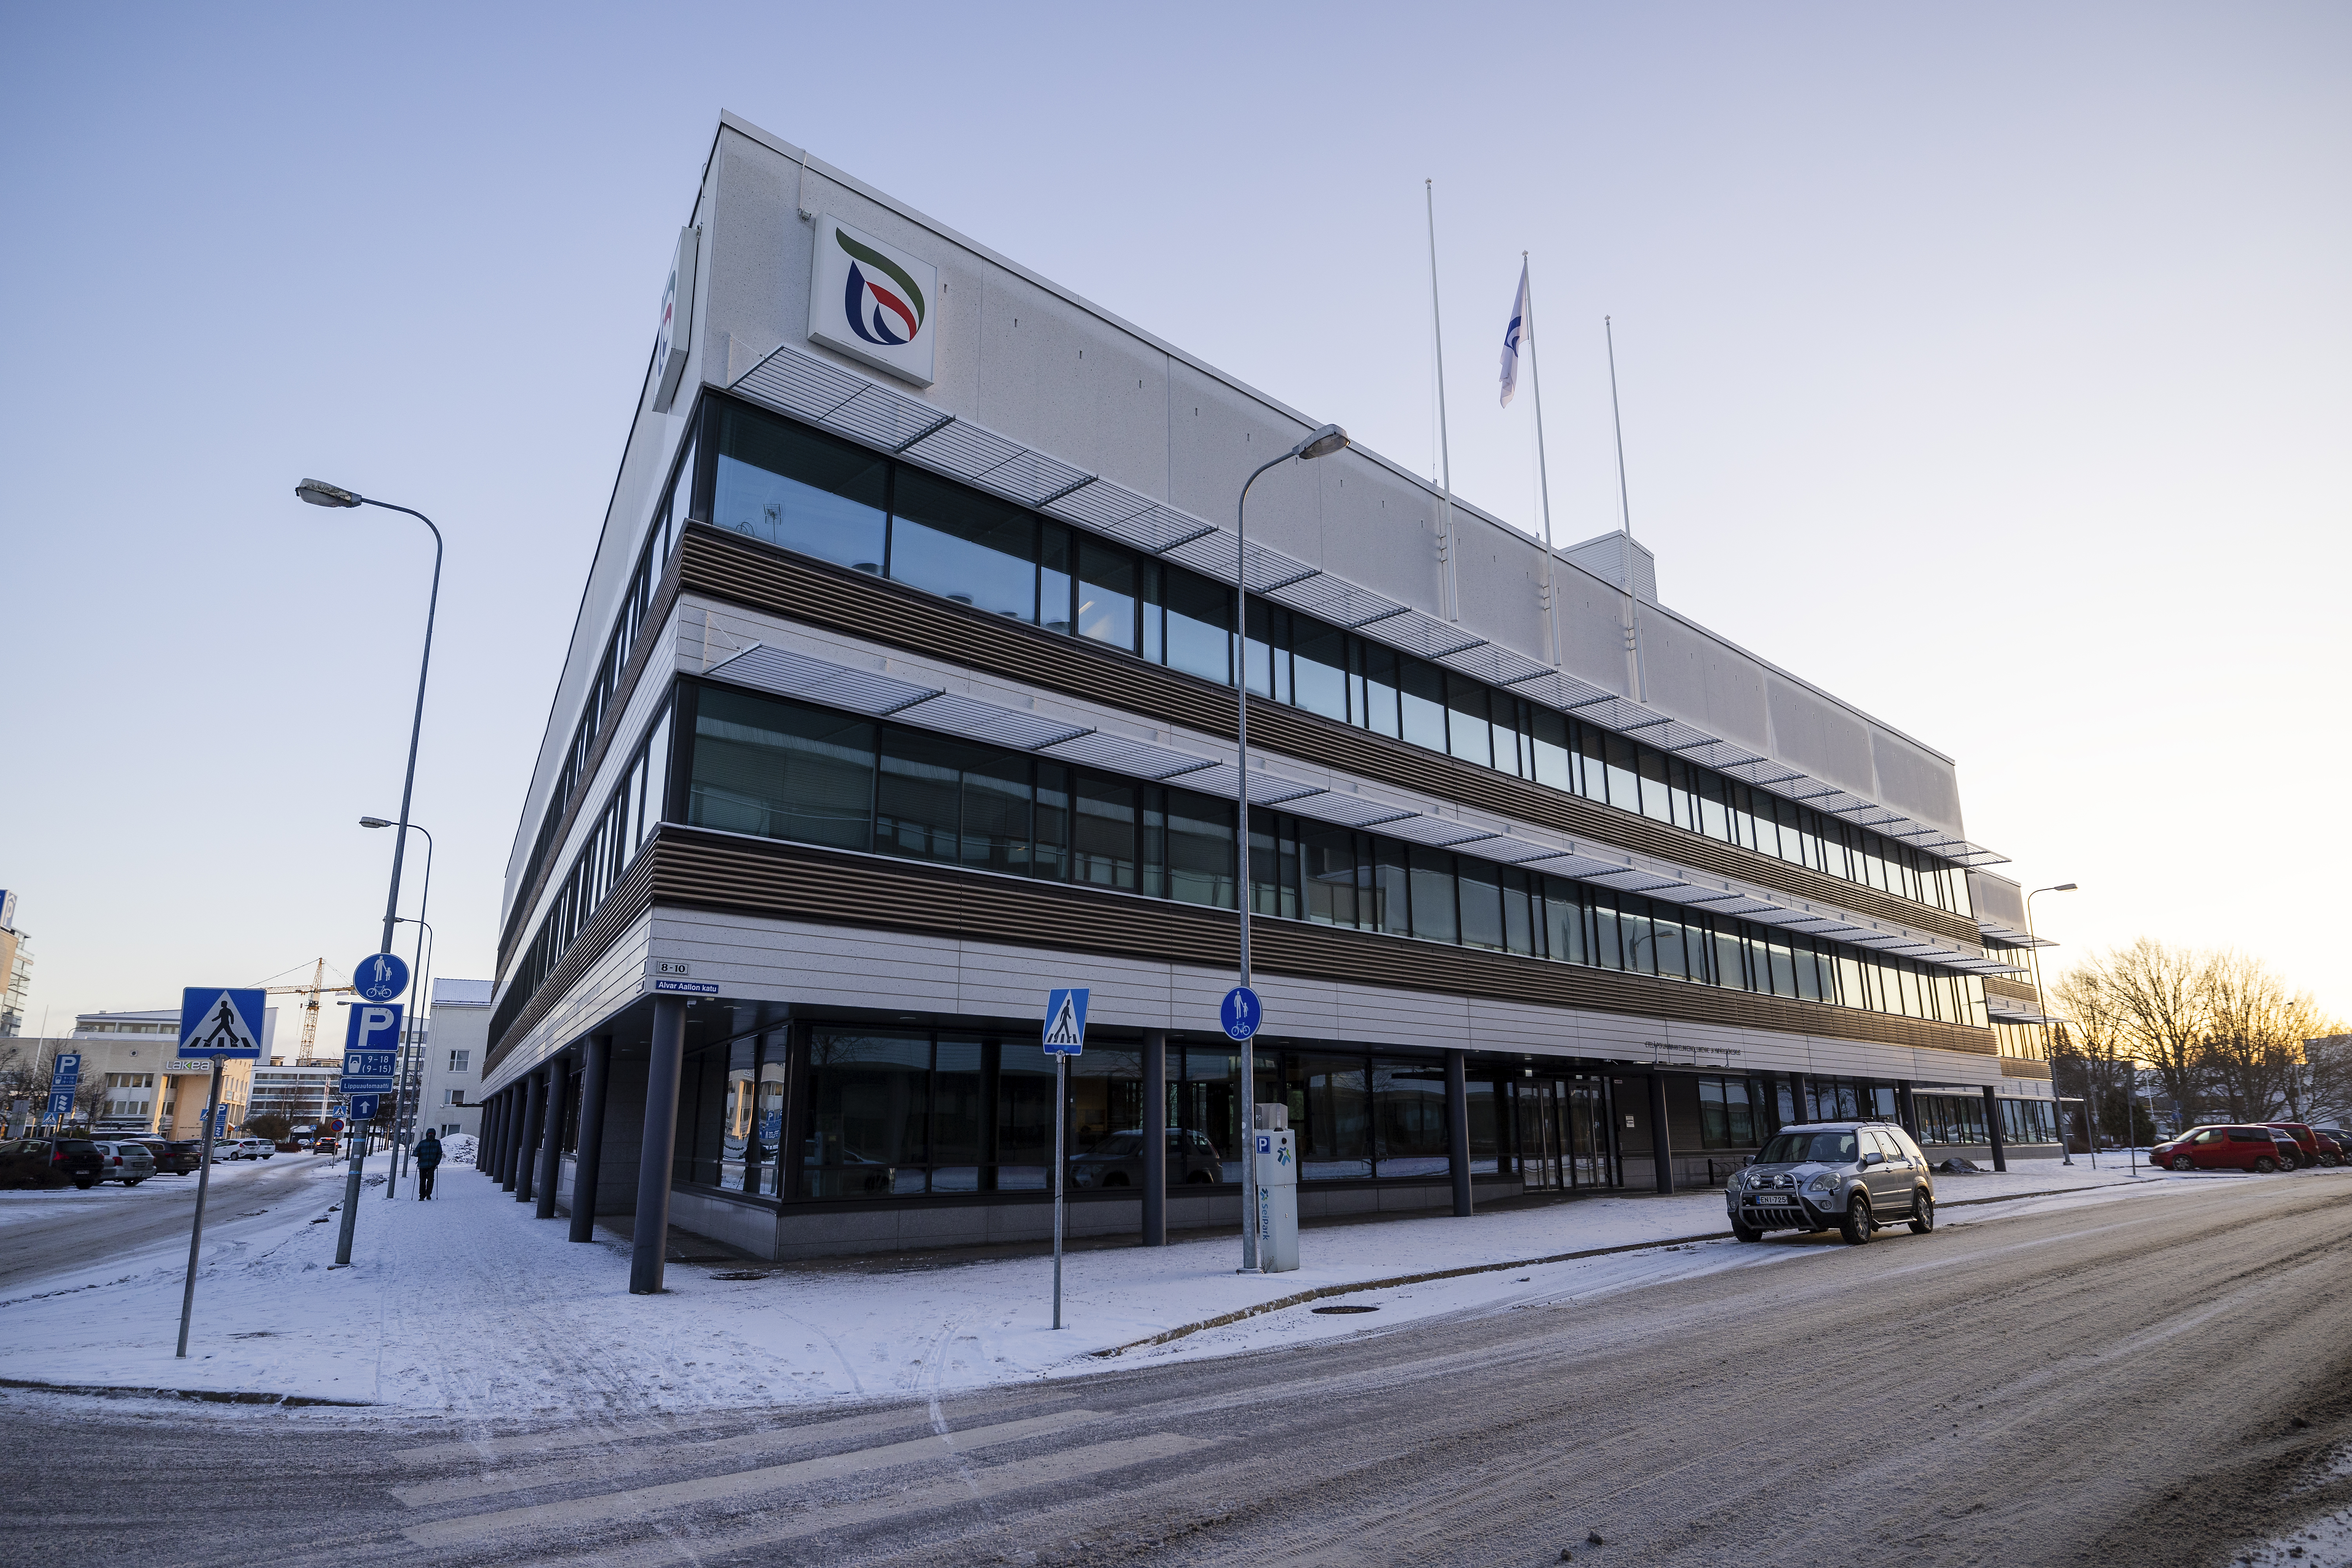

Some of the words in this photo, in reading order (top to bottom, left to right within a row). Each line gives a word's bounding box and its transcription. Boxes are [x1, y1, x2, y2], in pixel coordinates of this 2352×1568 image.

[4, 901, 13, 925] P
[358, 1007, 394, 1046] P
[59, 1056, 76, 1073] P
[217, 1105, 226, 1114] P
[1259, 1138, 1267, 1151] P
[1261, 1203, 1270, 1240] SeiPark
